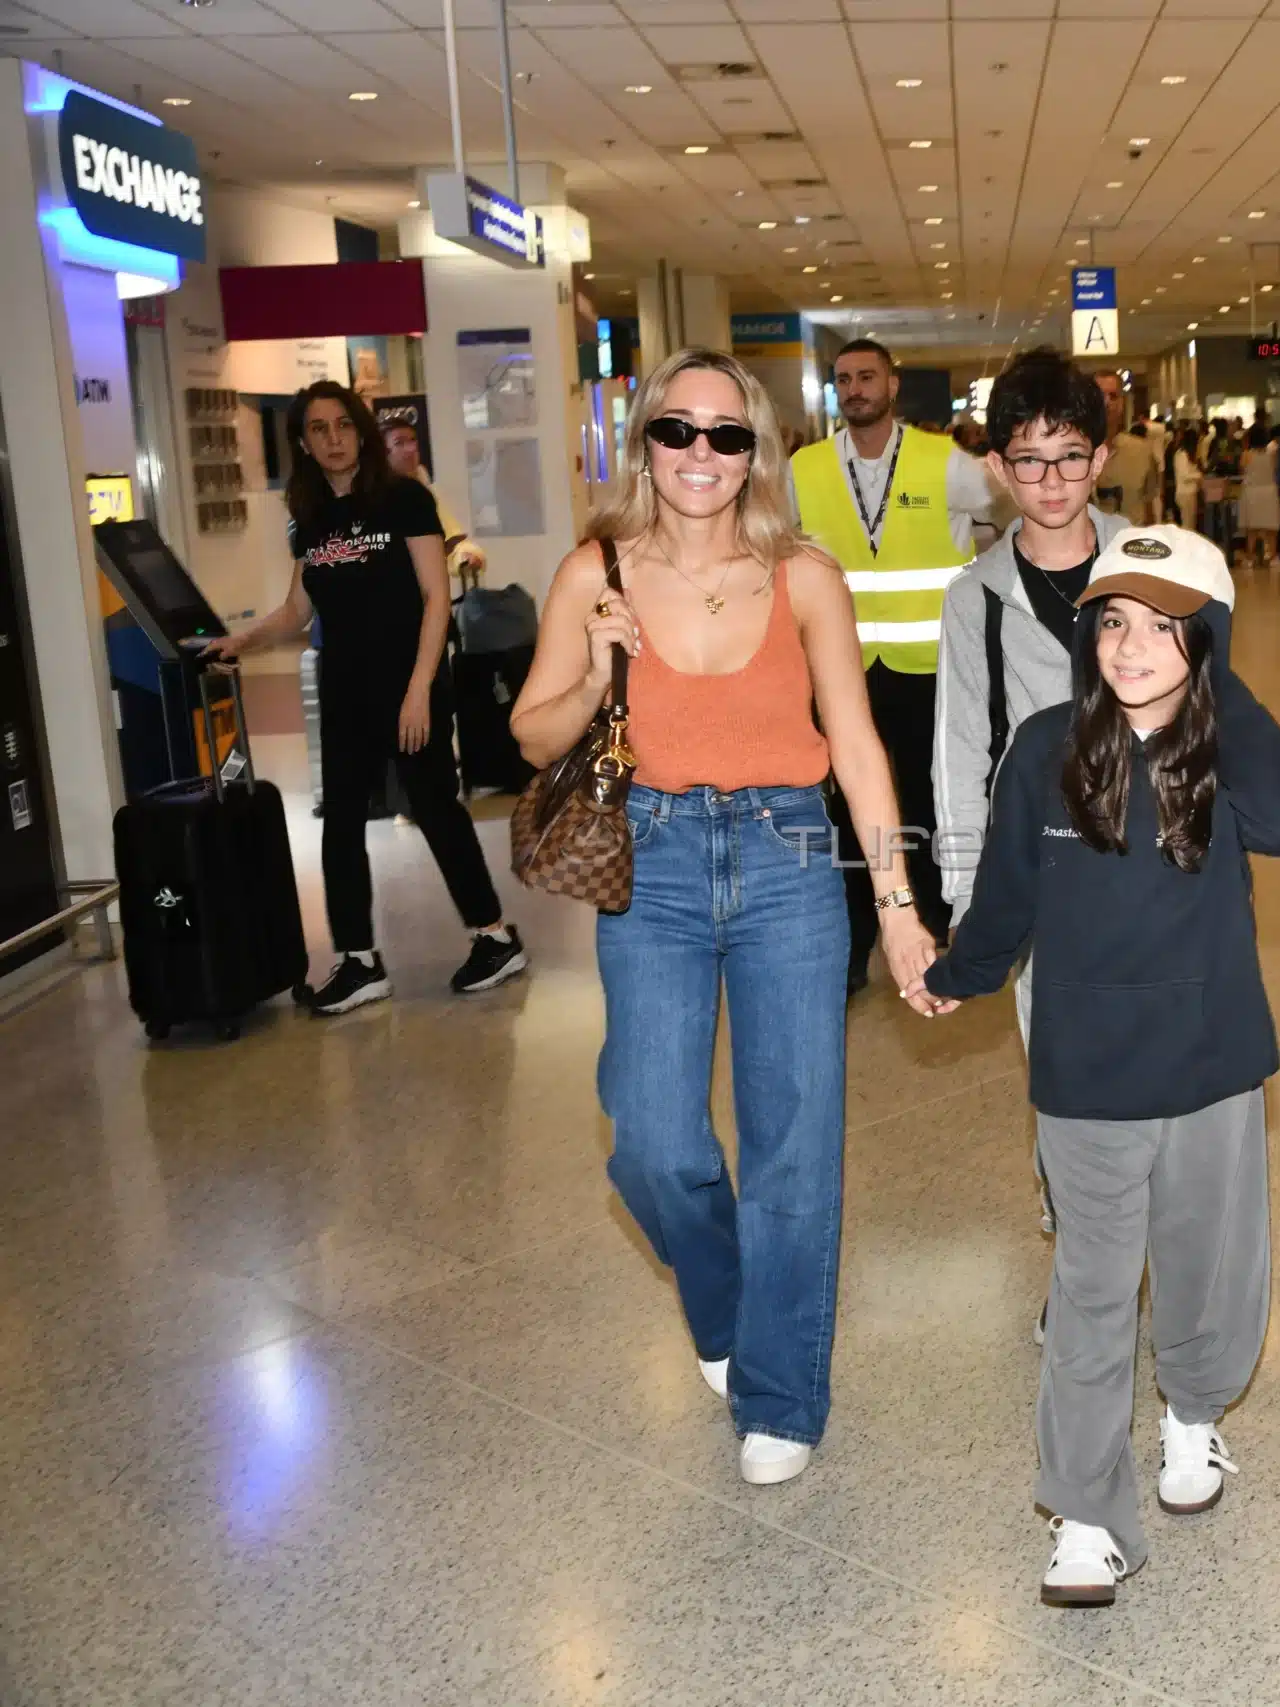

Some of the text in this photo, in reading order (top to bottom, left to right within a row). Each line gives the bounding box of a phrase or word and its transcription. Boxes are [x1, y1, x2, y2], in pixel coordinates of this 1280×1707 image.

[72, 133, 204, 226] EXCHANGE
[1085, 316, 1108, 350] A
[82, 378, 112, 403] ATM
